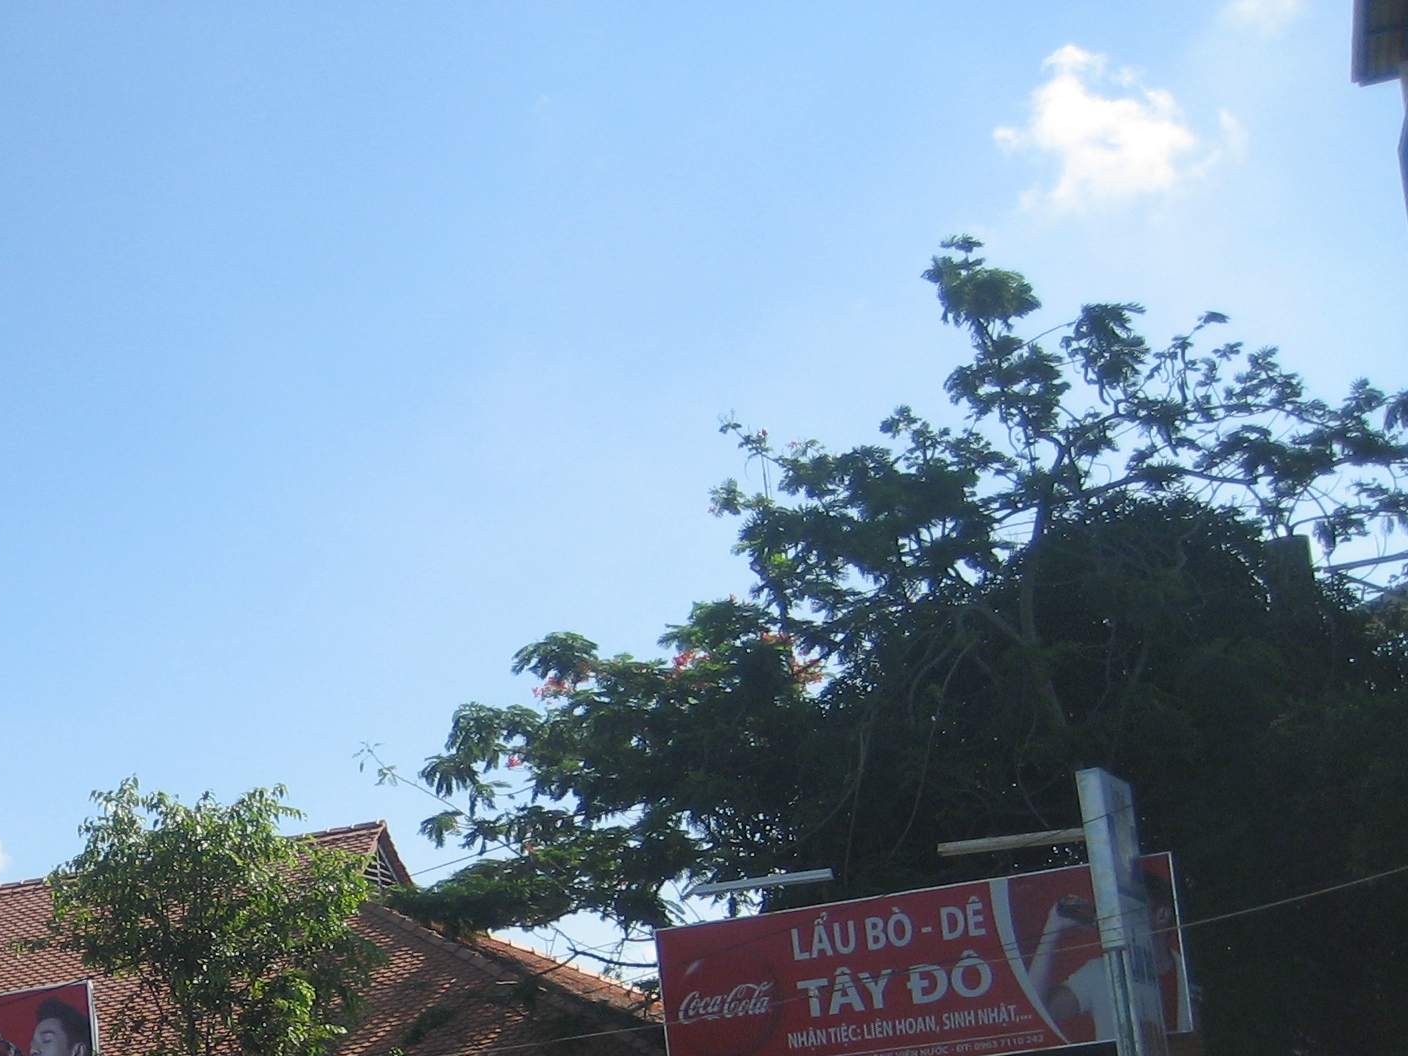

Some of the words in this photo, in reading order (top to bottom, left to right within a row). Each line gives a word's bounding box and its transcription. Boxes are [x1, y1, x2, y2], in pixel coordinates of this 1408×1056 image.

[791, 912, 856, 961] LẨU
[864, 906, 912, 951] BÒ
[939, 896, 986, 940] DÊ
[796, 967, 892, 1018] TÂY
[907, 949, 992, 1004] ĐÔ
[787, 1027, 827, 1051] NHẬN
[828, 1023, 862, 1046] TIỆC:
[863, 1019, 893, 1040] LIÊN
[895, 1015, 940, 1036] HOAN,
[942, 1010, 975, 1030] SINH
